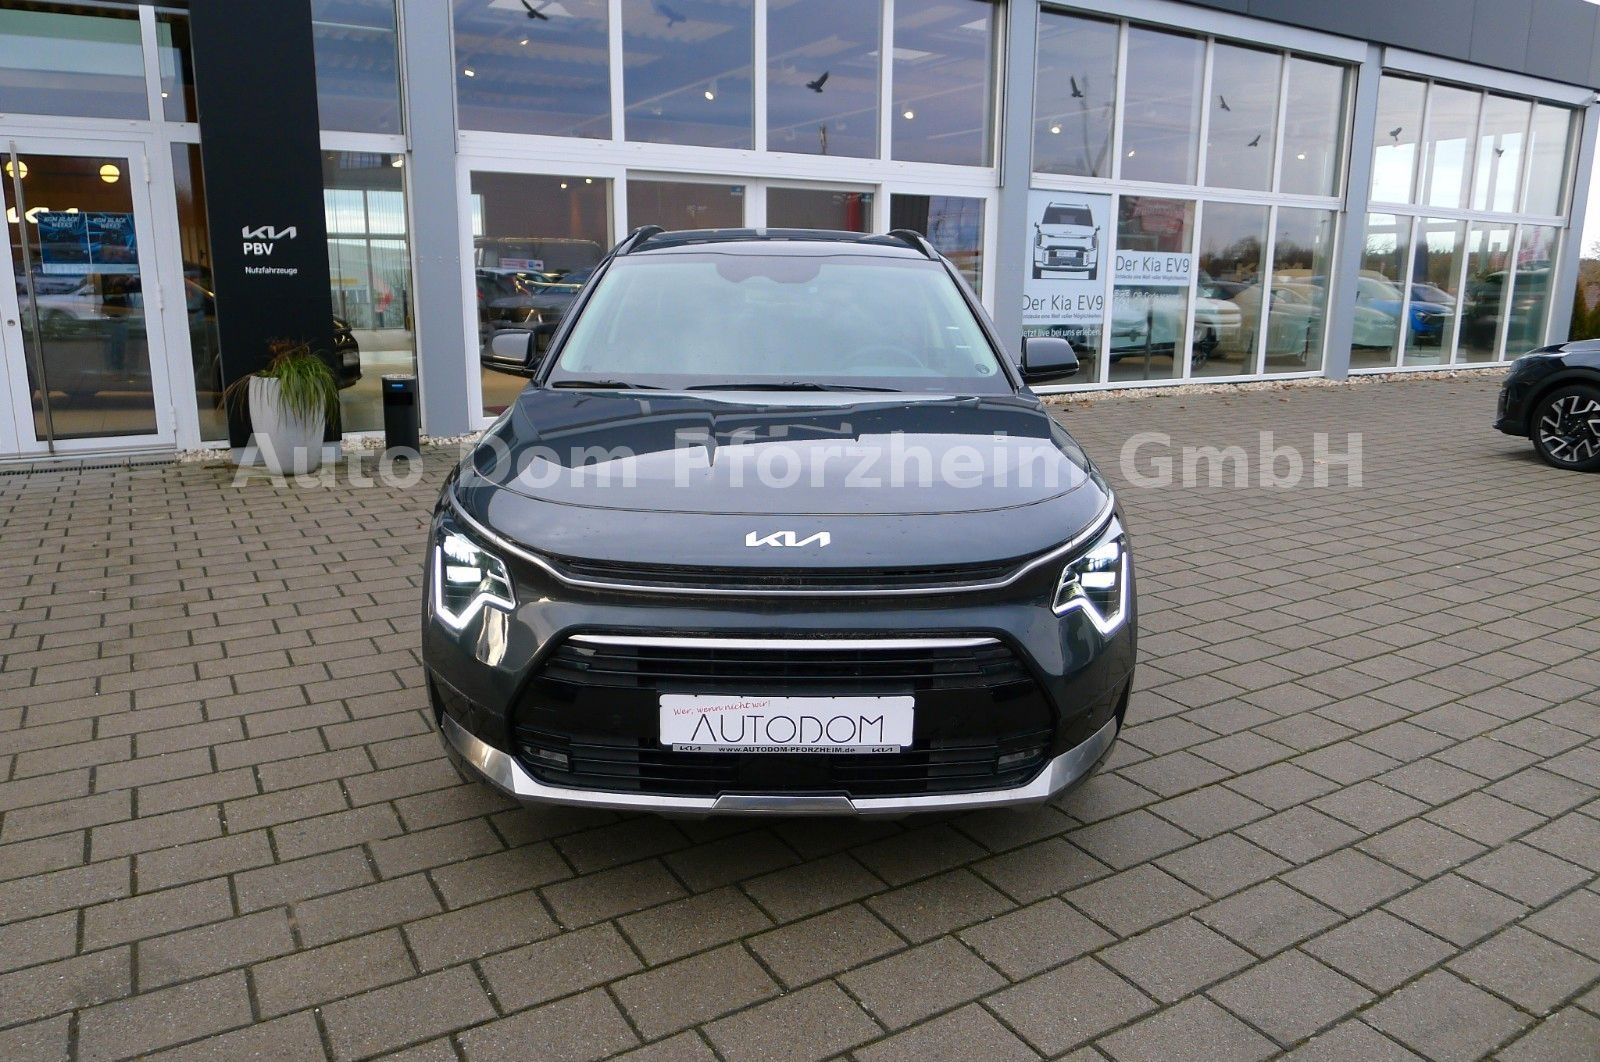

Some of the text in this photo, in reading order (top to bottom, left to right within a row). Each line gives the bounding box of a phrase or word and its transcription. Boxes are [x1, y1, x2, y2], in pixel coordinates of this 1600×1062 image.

[242, 225, 297, 239] KIA
[243, 242, 273, 255] PBV
[245, 266, 298, 276] Nutzfahrzeuge
[1115, 255, 1190, 273] Der Kia EV9
[1022, 294, 1104, 311] Der Kia EV9
[1062, 328, 1075, 336] uns
[745, 530, 831, 548] KIA
[673, 706, 694, 716] Wer,
[696, 704, 723, 714] wenn
[723, 701, 750, 712] nicht
[690, 713, 885, 744] AUTODOM
[718, 746, 856, 754] www.AUTODOM-PFORZHEIM.de
